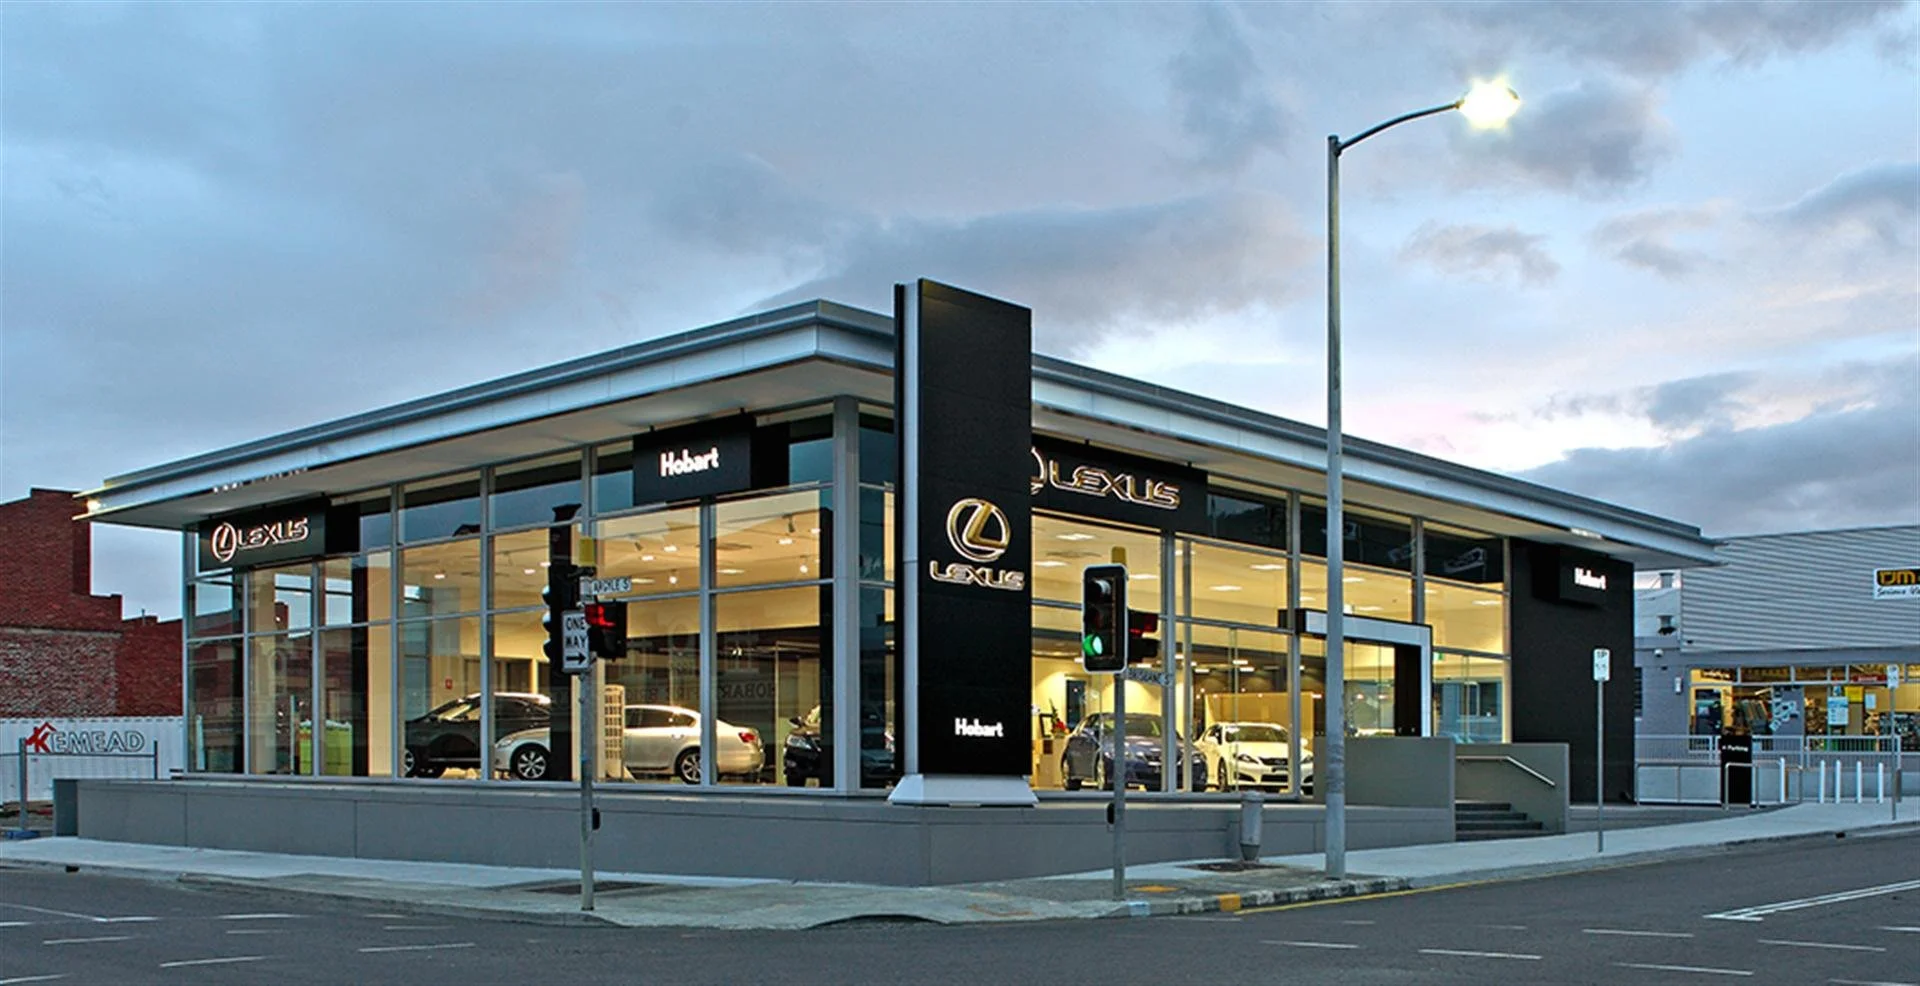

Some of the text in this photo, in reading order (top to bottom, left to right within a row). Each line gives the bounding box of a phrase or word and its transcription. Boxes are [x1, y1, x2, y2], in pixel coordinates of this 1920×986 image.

[660, 447, 719, 477] Hobart
[1049, 460, 1180, 510] LEXUS
[238, 518, 308, 549] LEXUS
[929, 560, 1025, 591] LEXUS
[1574, 567, 1606, 589] Hobart
[566, 617, 585, 631] ONE
[566, 635, 587, 649] WAY
[26, 723, 145, 753] KEMEAD
[955, 717, 1004, 737] Hobart
